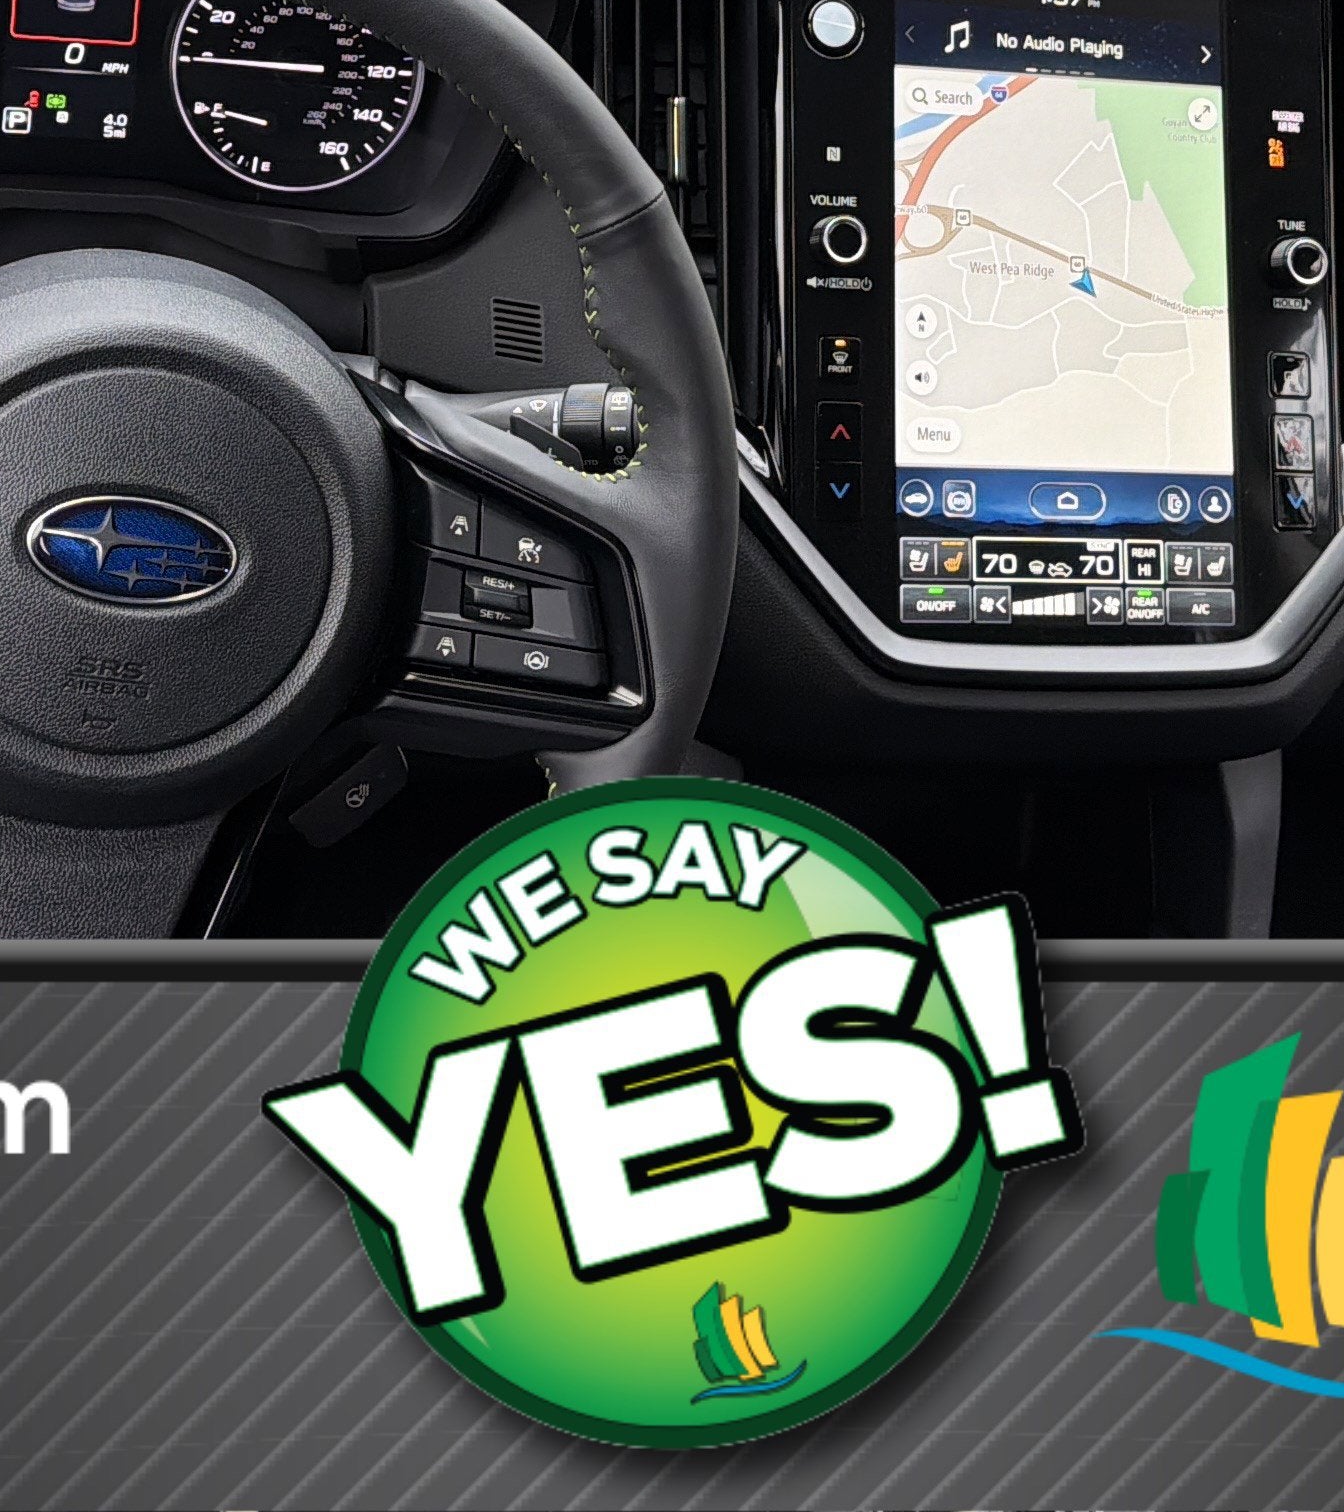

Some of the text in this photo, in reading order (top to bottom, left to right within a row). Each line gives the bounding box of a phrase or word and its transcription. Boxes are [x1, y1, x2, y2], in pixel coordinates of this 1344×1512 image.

[209, 10, 235, 24] 20
[296, 7, 314, 15] 100
[263, 15, 278, 24] 60
[250, 26, 265, 34] 40
[328, 23, 346, 32] 140
[241, 40, 256, 49] 20
[996, 32, 1124, 60] No Audio Playing
[64, 42, 85, 65] 0
[101, 62, 129, 74] MPH
[367, 66, 396, 79] 120
[337, 71, 358, 79] 200
[934, 89, 973, 106] Search
[8, 111, 27, 129] P
[353, 108, 382, 122] 140
[319, 142, 349, 155] 160
[260, 162, 271, 172] E
[810, 194, 857, 207] VOLUME
[1277, 219, 1306, 231] TUNE
[969, 261, 1055, 280] West Pea Ridge
[829, 278, 860, 288] HOLD
[1274, 299, 1302, 309] HOLD
[827, 365, 853, 374] FRONT
[917, 427, 951, 443] Menu
[1131, 548, 1156, 558] REAR
[981, 553, 1017, 574] 70
[1079, 555, 1114, 576] 70
[1137, 563, 1152, 577] HI
[916, 600, 956, 612] ON/OFF
[1131, 597, 1159, 607] REAR
[1127, 608, 1164, 620] ON/OFF
[1191, 603, 1211, 615] A/C
[78, 657, 143, 679] SRS
